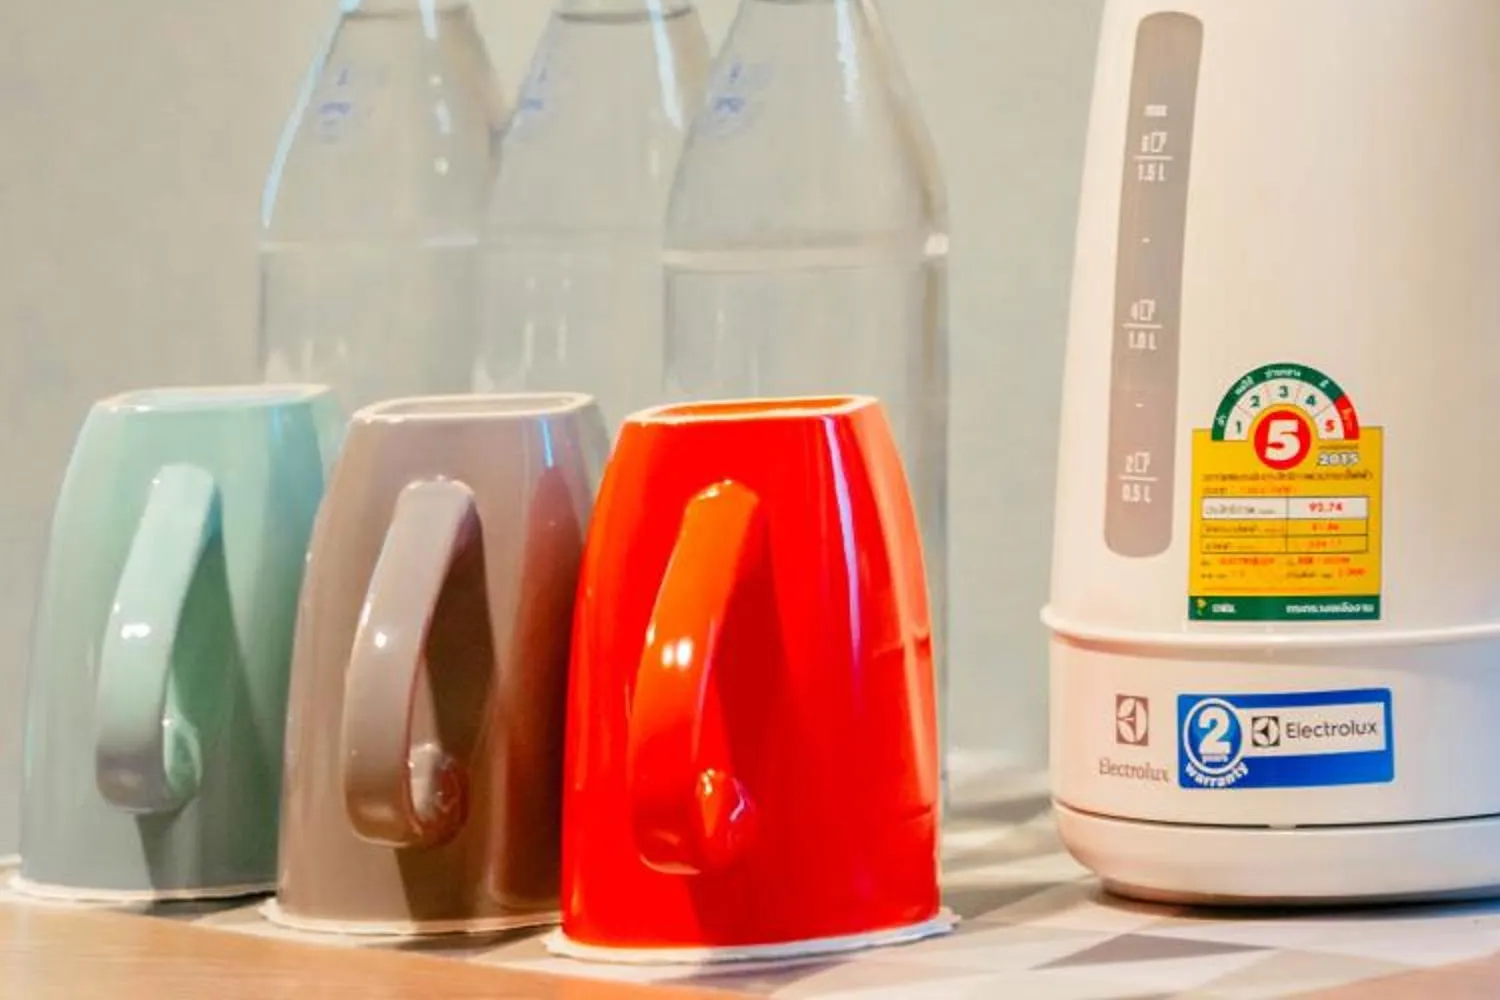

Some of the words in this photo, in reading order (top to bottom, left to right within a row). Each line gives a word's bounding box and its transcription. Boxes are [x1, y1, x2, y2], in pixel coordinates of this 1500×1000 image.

[1279, 385, 1289, 398] 3
[1250, 395, 1260, 408] 2
[1305, 394, 1316, 407] 4
[1235, 420, 1242, 433] 1
[1325, 419, 1335, 432] 5
[1264, 419, 1301, 461] 5
[1198, 706, 1231, 754] 2
[1285, 719, 1377, 739] Electrolux
[1099, 757, 1169, 783] Electrolux
